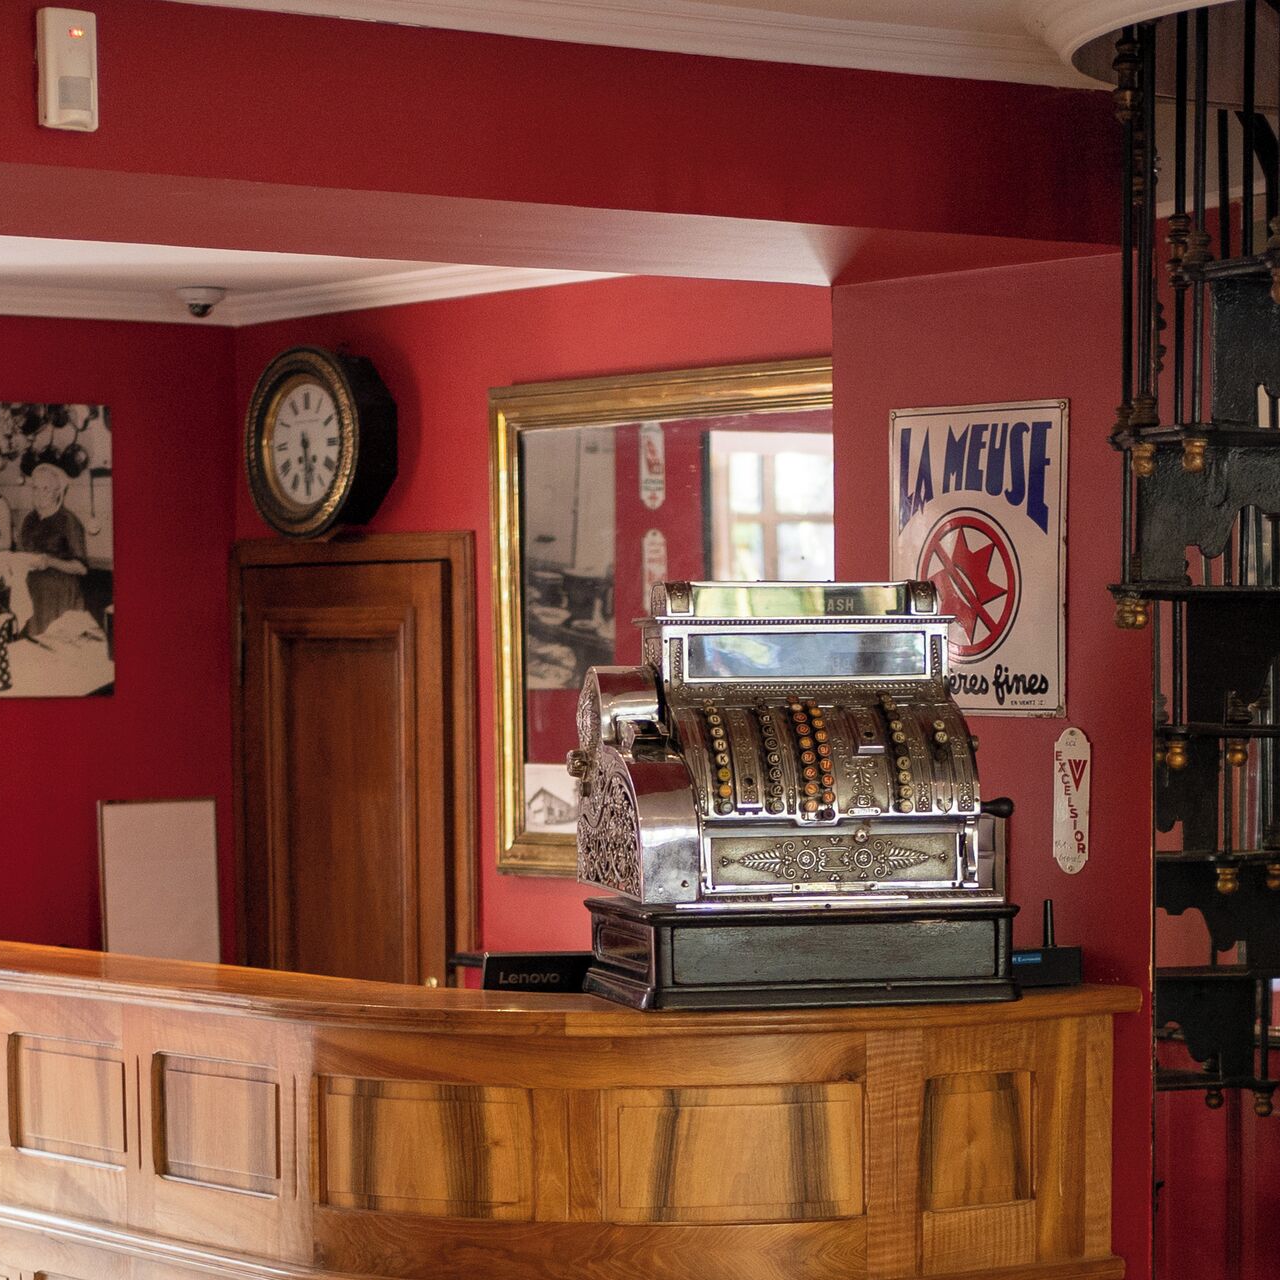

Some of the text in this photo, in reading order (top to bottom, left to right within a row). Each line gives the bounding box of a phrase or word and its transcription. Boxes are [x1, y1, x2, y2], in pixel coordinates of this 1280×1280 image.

[899, 421, 1052, 536] LA MEUSE
[826, 598, 854, 611] ASH
[949, 664, 1049, 705] ères fines
[1055, 750, 1086, 854] EXCELSIOR
[499, 972, 560, 985] Lenovo
